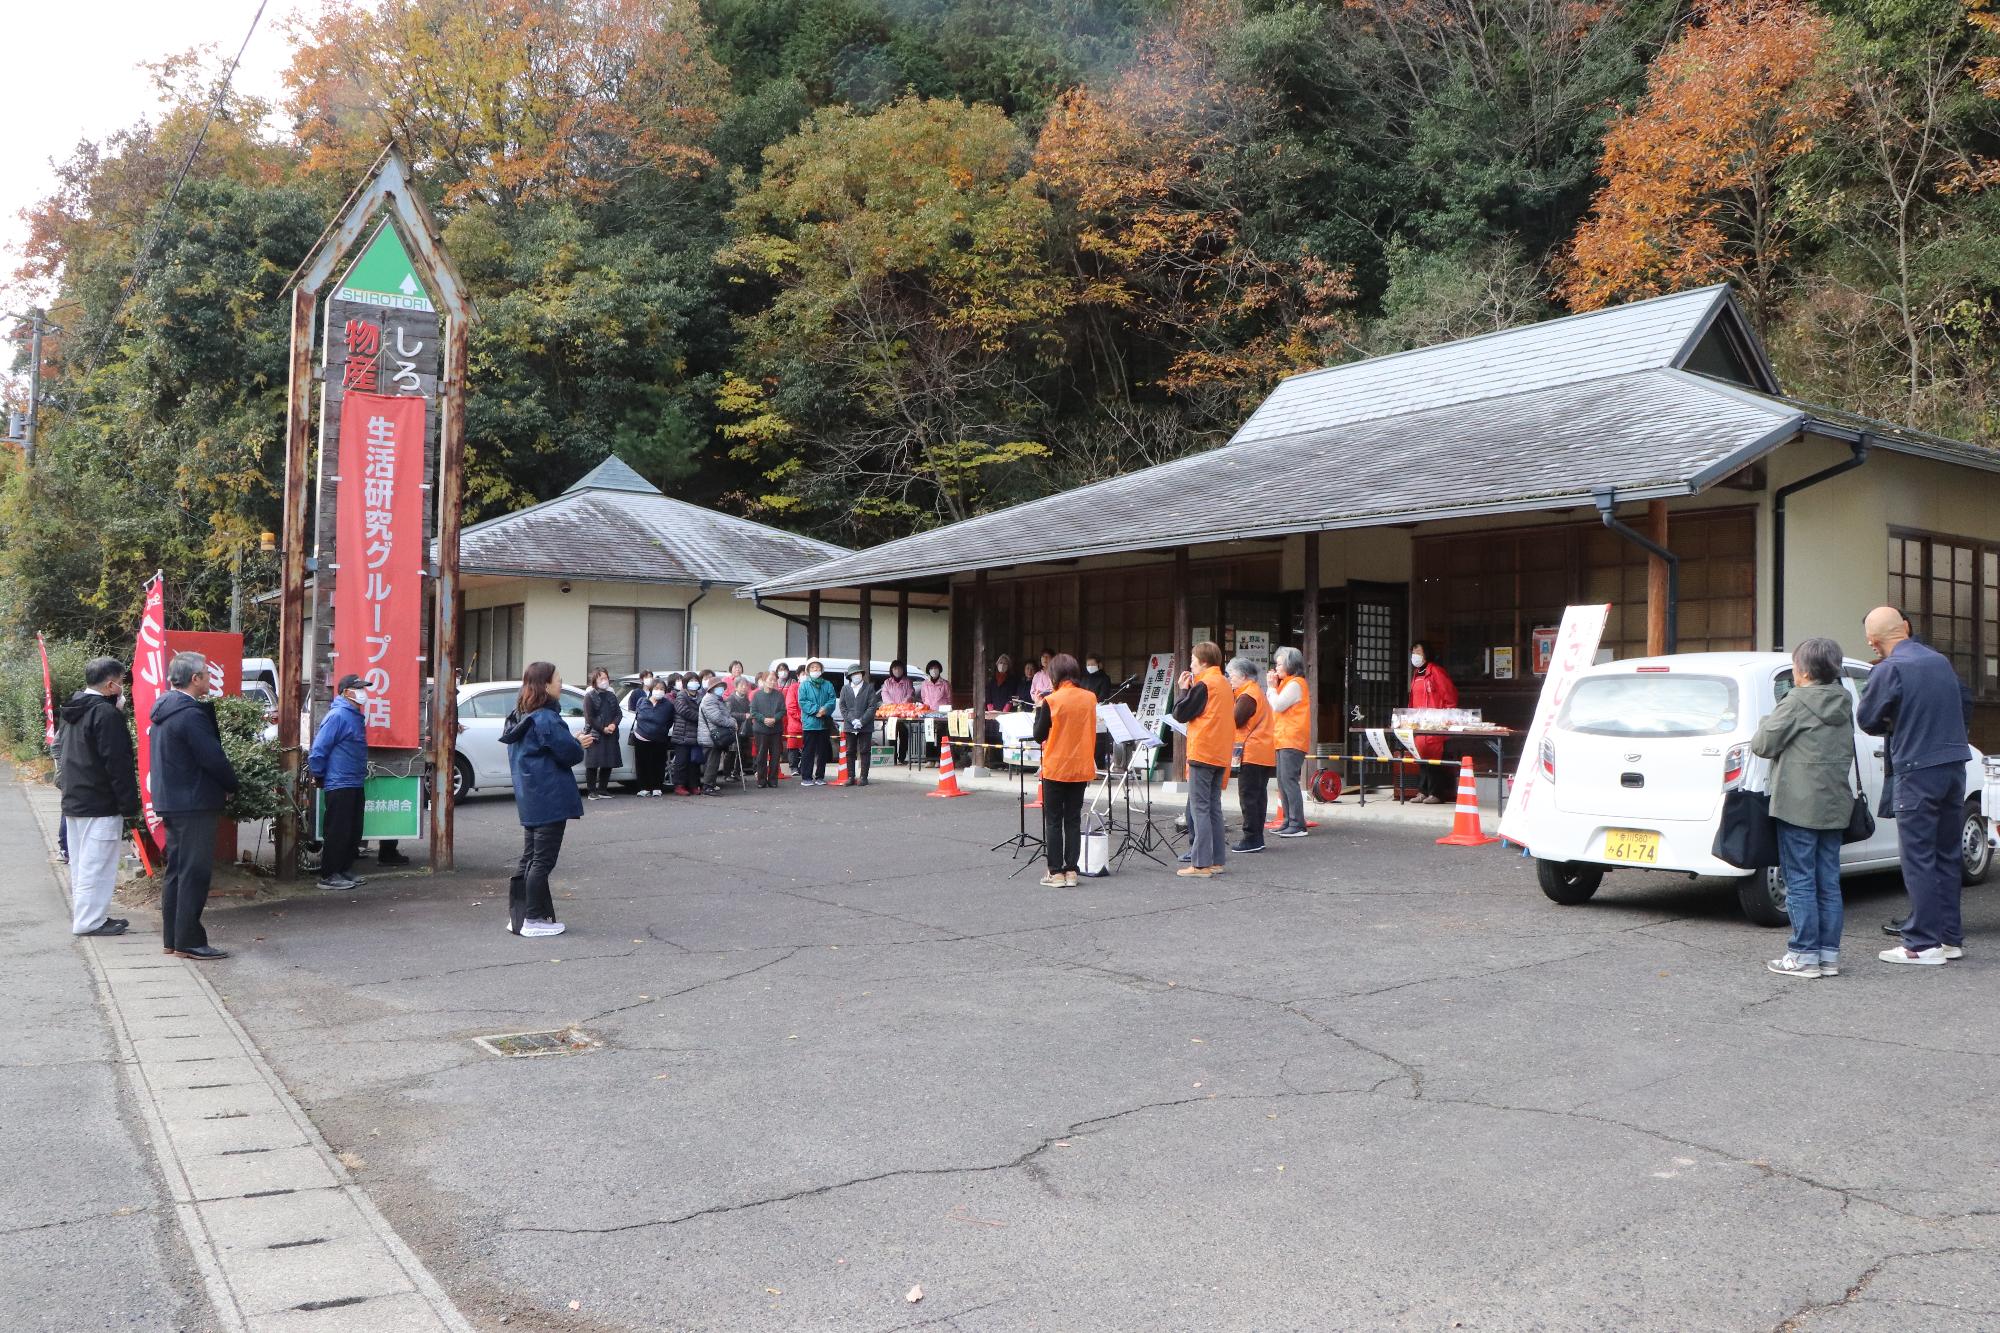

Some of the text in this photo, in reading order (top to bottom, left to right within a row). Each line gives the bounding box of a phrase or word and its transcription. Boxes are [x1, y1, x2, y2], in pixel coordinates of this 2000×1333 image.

[342, 289, 428, 310] SHIROTORI
[392, 326, 423, 397] しろ
[364, 415, 396, 729] 生活研究グループの店
[1616, 843, 1655, 861] 61-74
